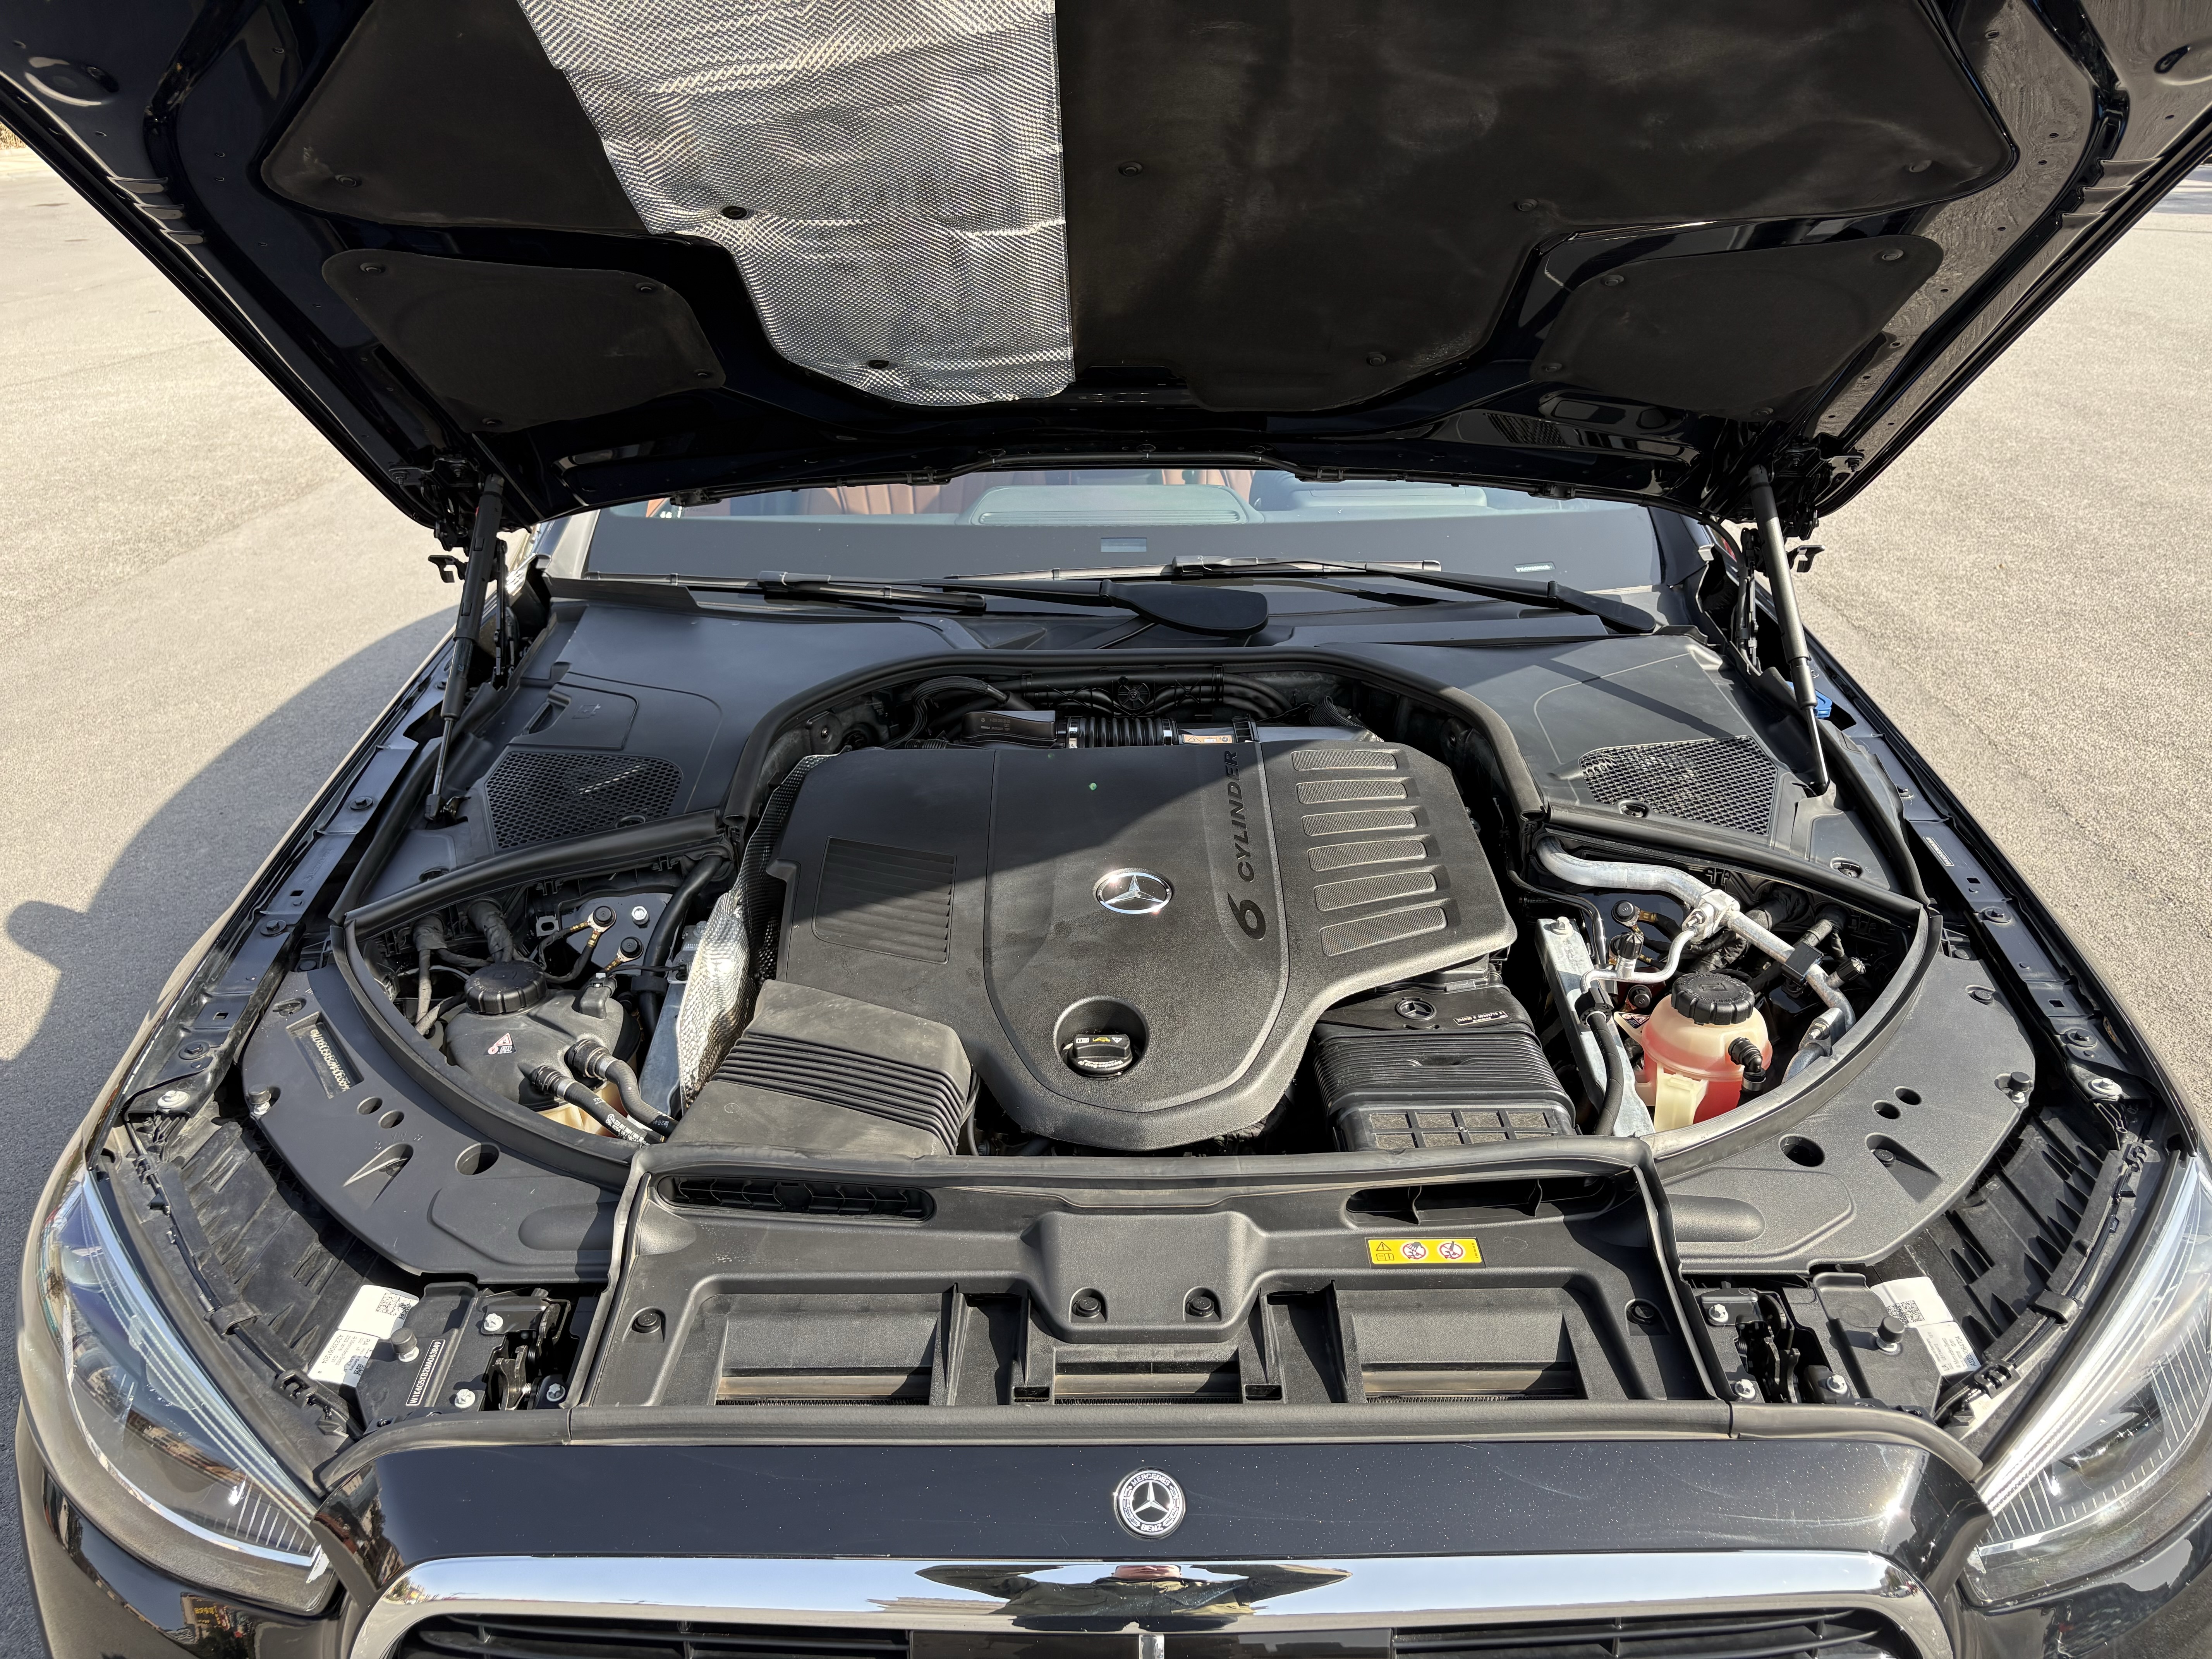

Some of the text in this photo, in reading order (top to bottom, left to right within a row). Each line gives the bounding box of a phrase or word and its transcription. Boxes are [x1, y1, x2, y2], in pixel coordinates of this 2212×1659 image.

[1224, 750, 1266, 941] 6 CYLINDER
[1131, 1473, 1171, 1486] MERCEDES
[1140, 1523, 1164, 1532] BENZ
